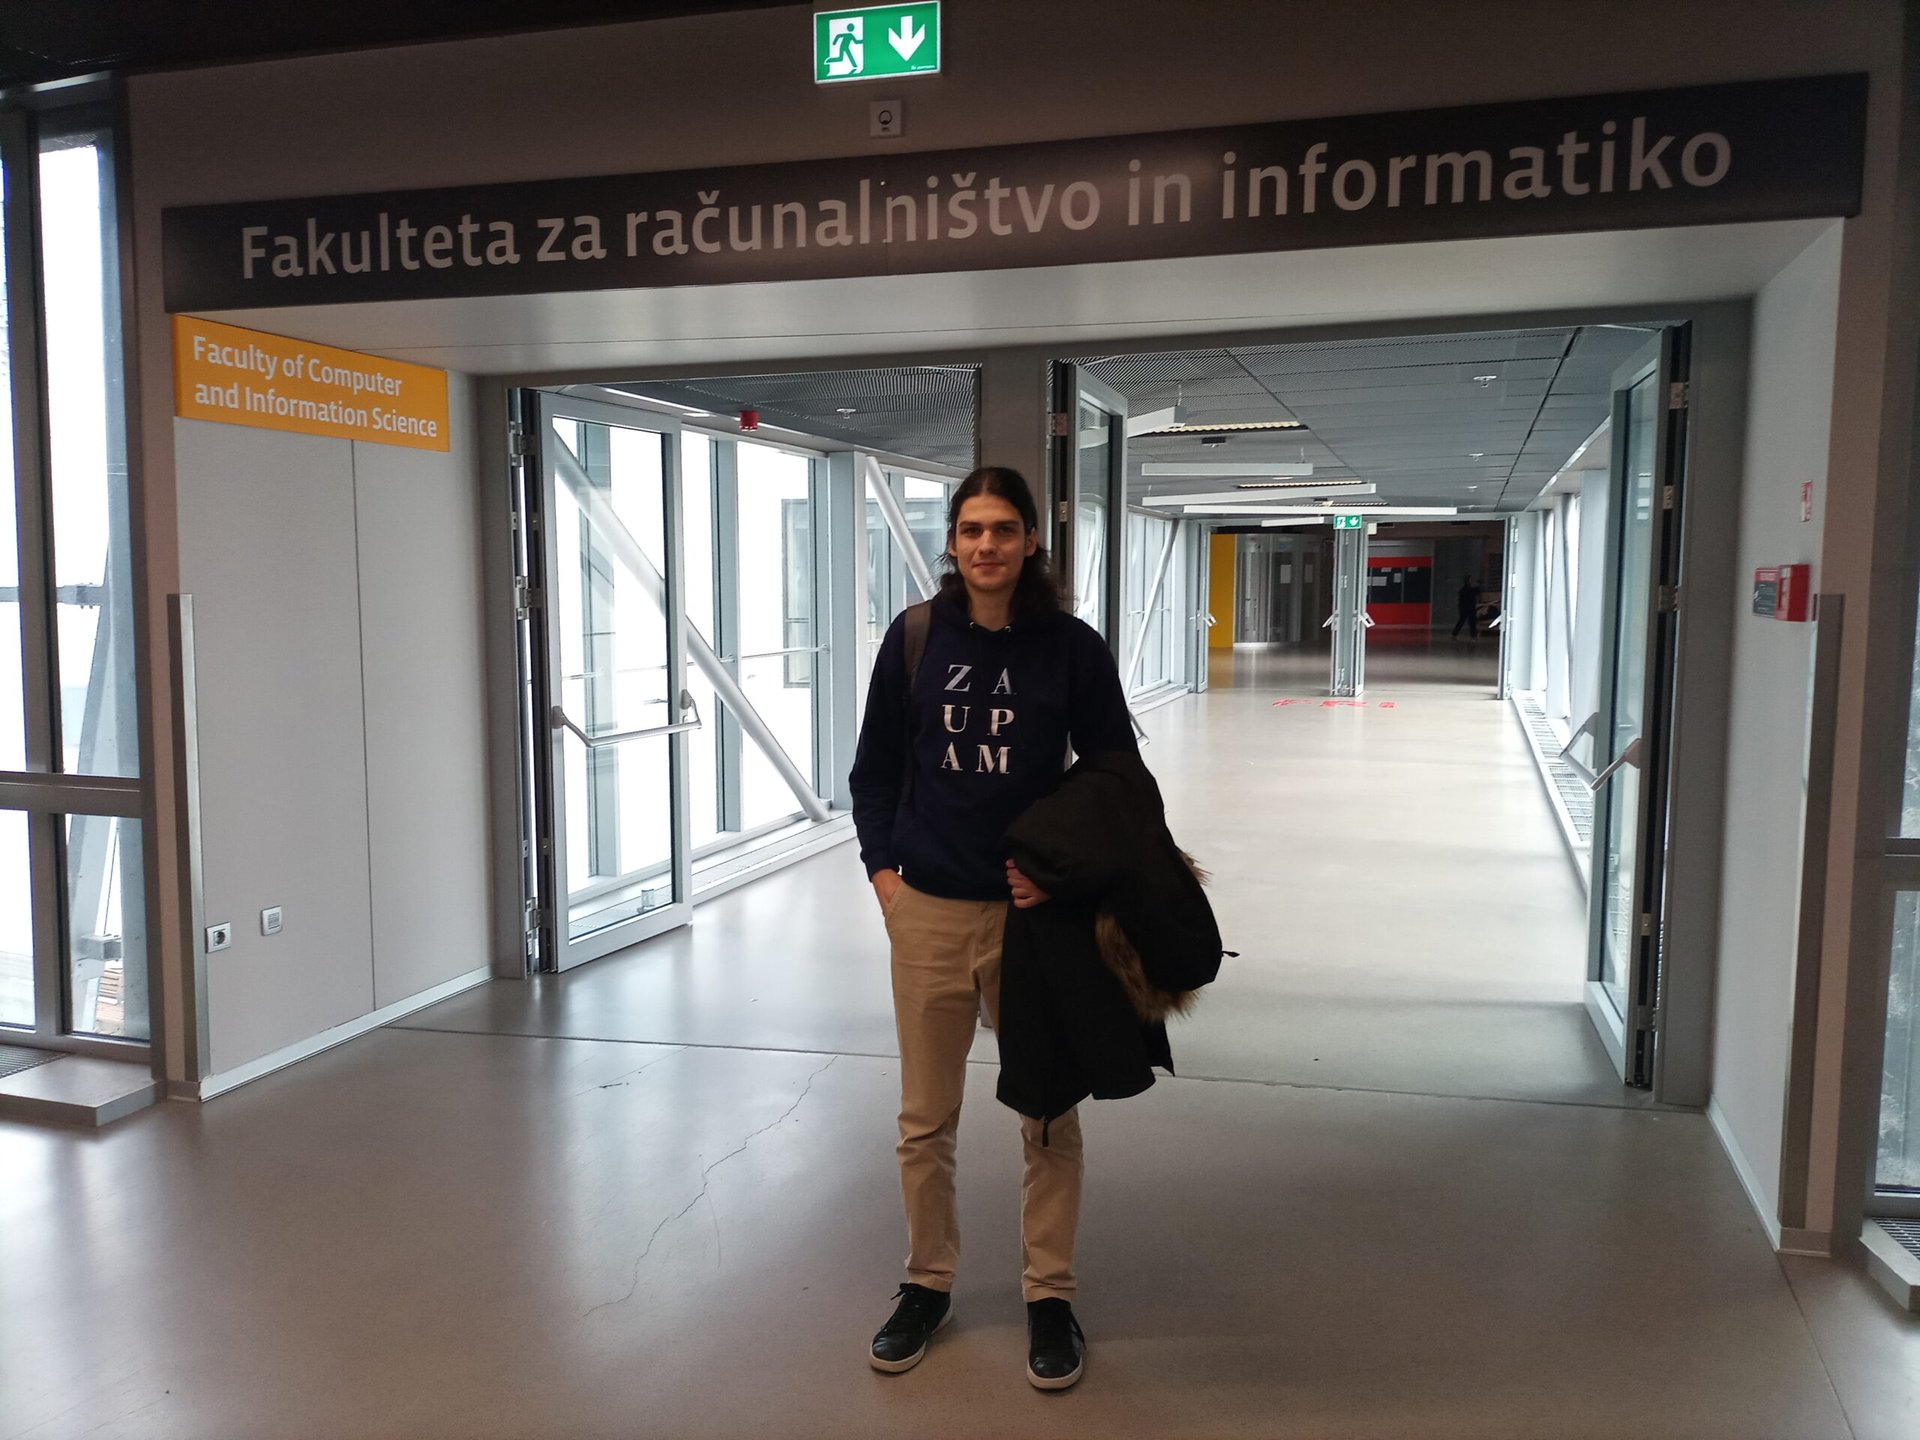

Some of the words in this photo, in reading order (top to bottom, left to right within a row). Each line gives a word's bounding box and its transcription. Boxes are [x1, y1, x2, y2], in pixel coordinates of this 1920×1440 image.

[242, 212, 520, 279] Fakulteta
[536, 214, 606, 262] za
[626, 171, 1100, 257] računalništvo
[1128, 159, 1191, 225] in
[1222, 116, 1731, 219] informatiko
[193, 335, 278, 380] Faculty
[282, 354, 304, 379] of
[308, 359, 403, 396] Computer
[195, 383, 240, 409] and
[245, 386, 368, 428] Information
[372, 407, 438, 438] Science
